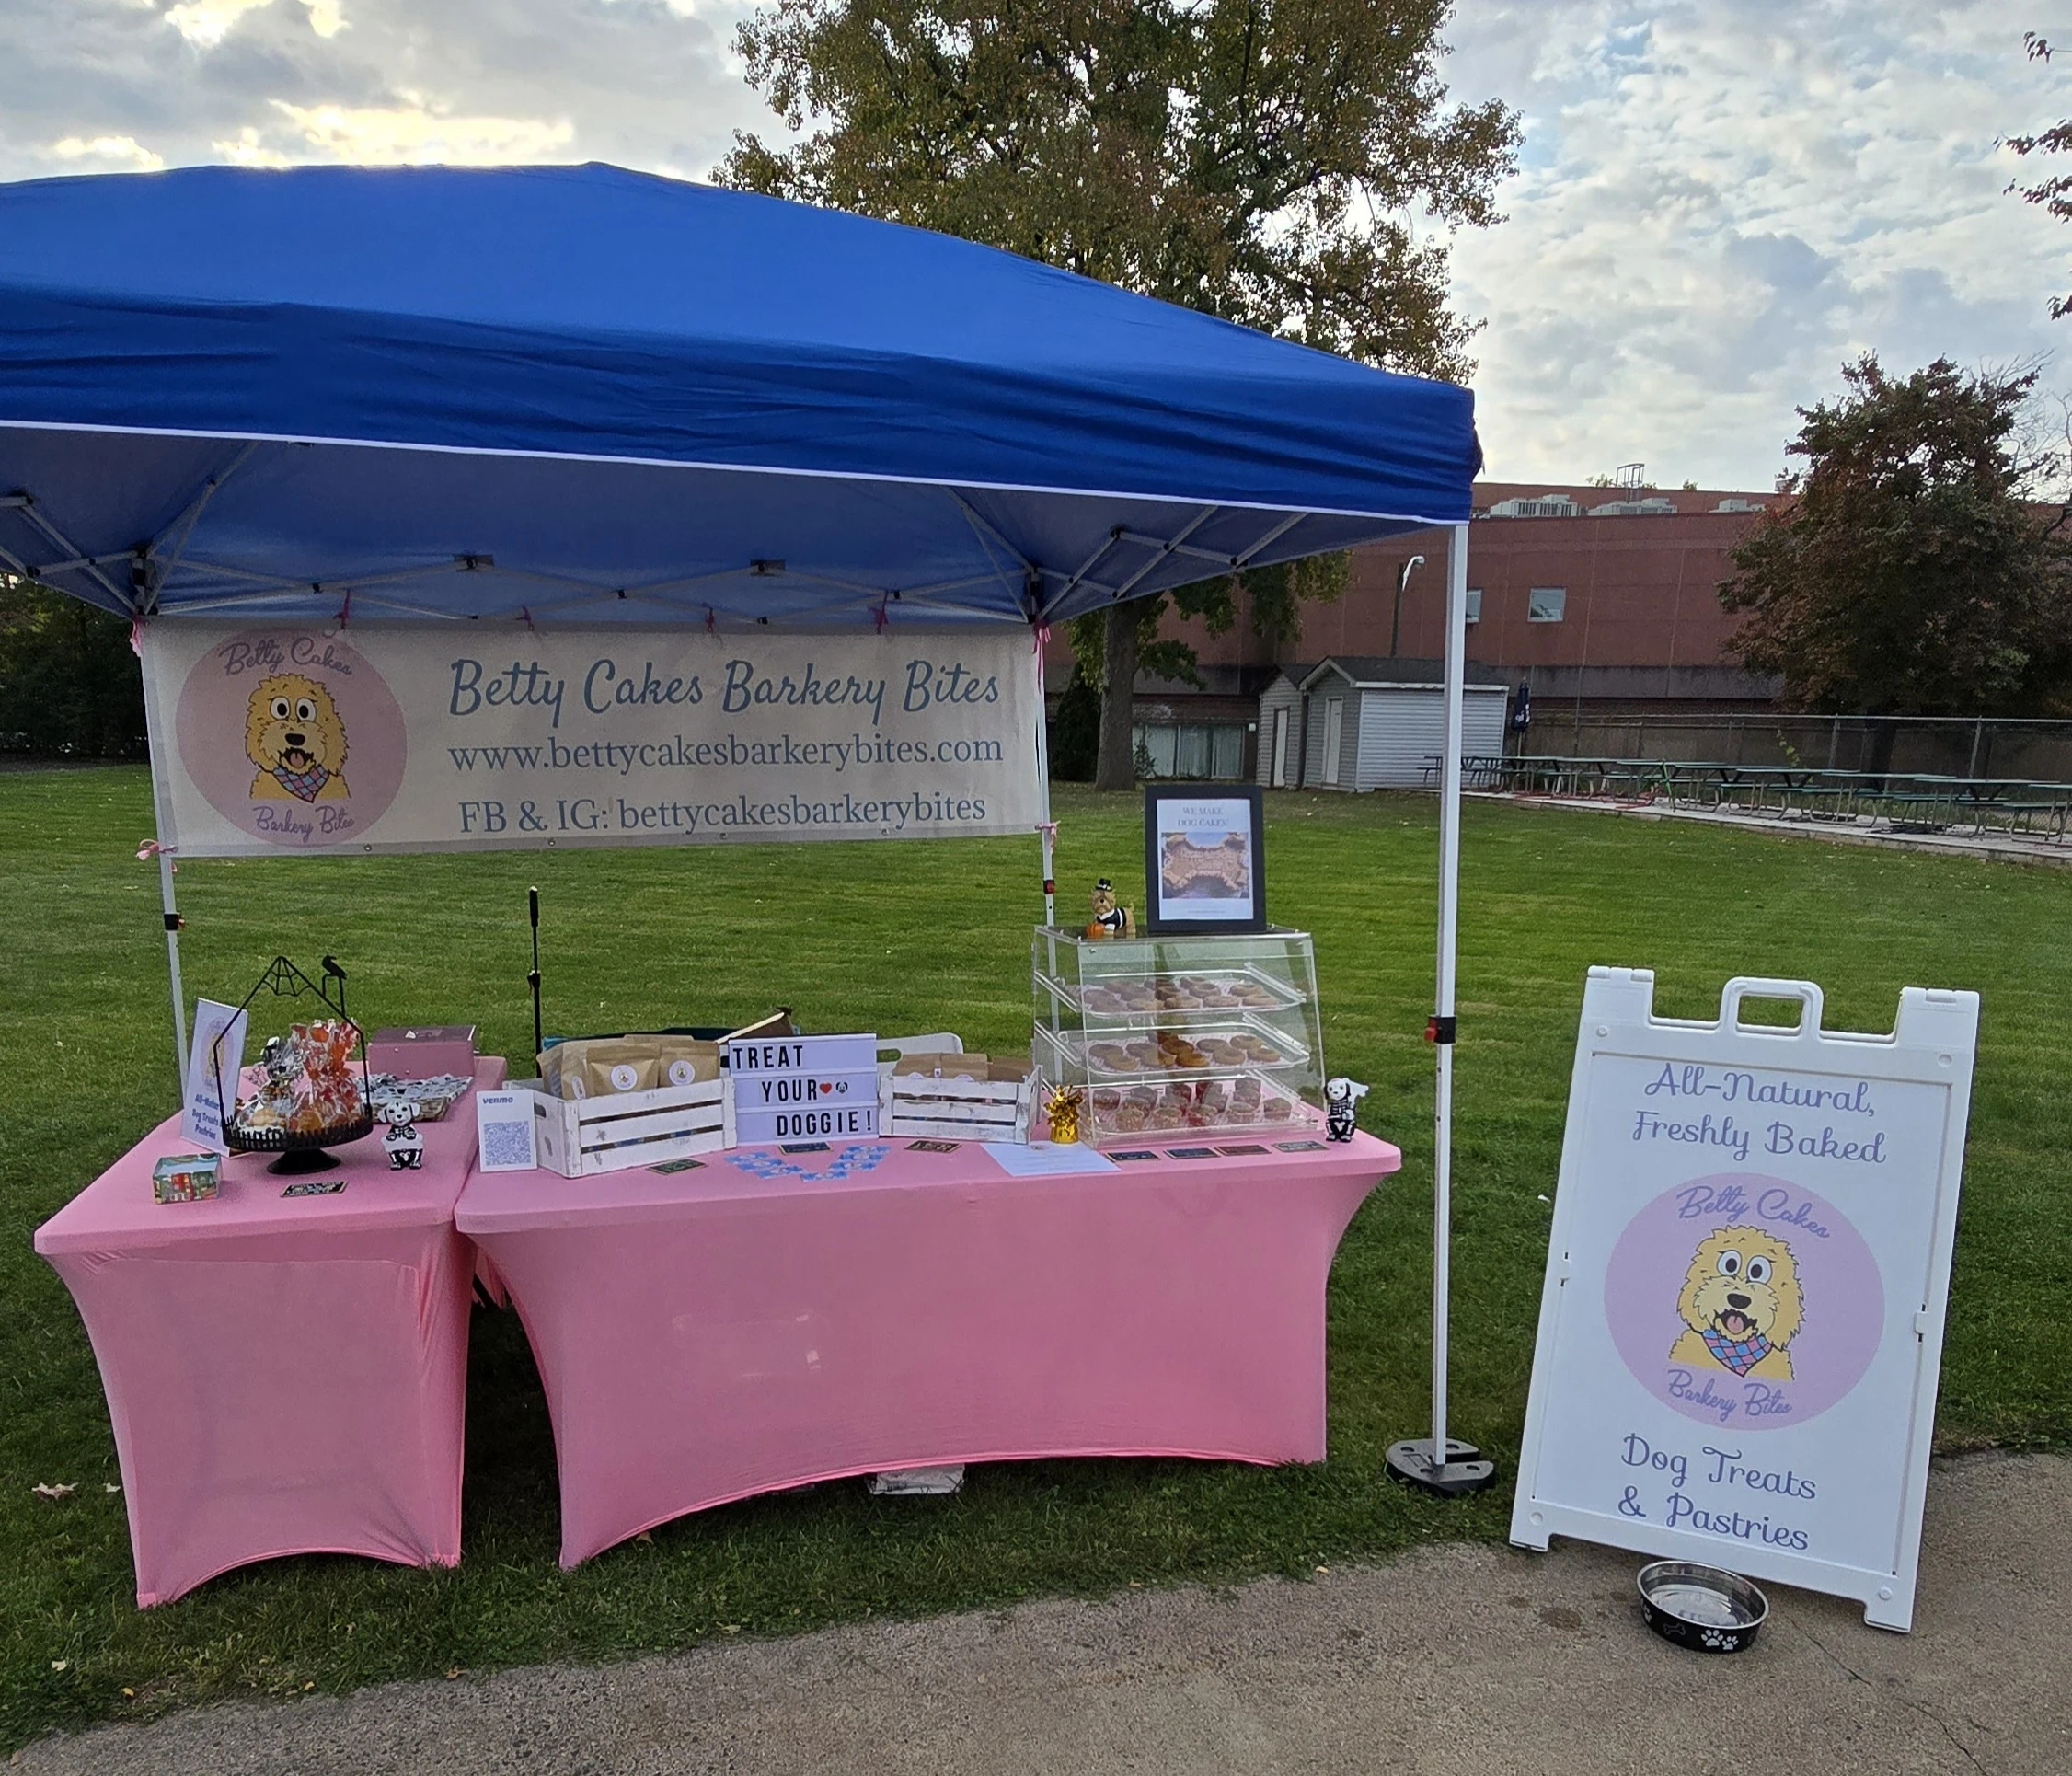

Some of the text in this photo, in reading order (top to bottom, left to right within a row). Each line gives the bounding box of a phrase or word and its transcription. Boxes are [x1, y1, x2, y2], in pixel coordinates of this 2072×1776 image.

[218, 636, 353, 676] Betty Cakes
[449, 659, 999, 729] Betty Cakes Barkery Bites
[447, 733, 1004, 776] www.bettycakesbarkerybites.com
[253, 805, 355, 844] Barkery Bites
[458, 791, 986, 836] FB & IG: bettycakesbarkerybites
[1178, 819, 1196, 827] DOG
[1182, 807, 1223, 815] WE MAKE
[732, 1045, 803, 1069] TREAT
[761, 1078, 818, 1103] YOUR
[1643, 1062, 1875, 1117] All-Natural,
[191, 1107, 202, 1124] Dog
[1632, 1110, 1887, 1163] Freshly Baked
[1676, 1185, 1831, 1240] Betty Cakes
[1667, 1369, 1793, 1422] Barkery Bites
[1621, 1433, 1817, 1499] Dog Treats
[1617, 1485, 1810, 1551] & Pastries
